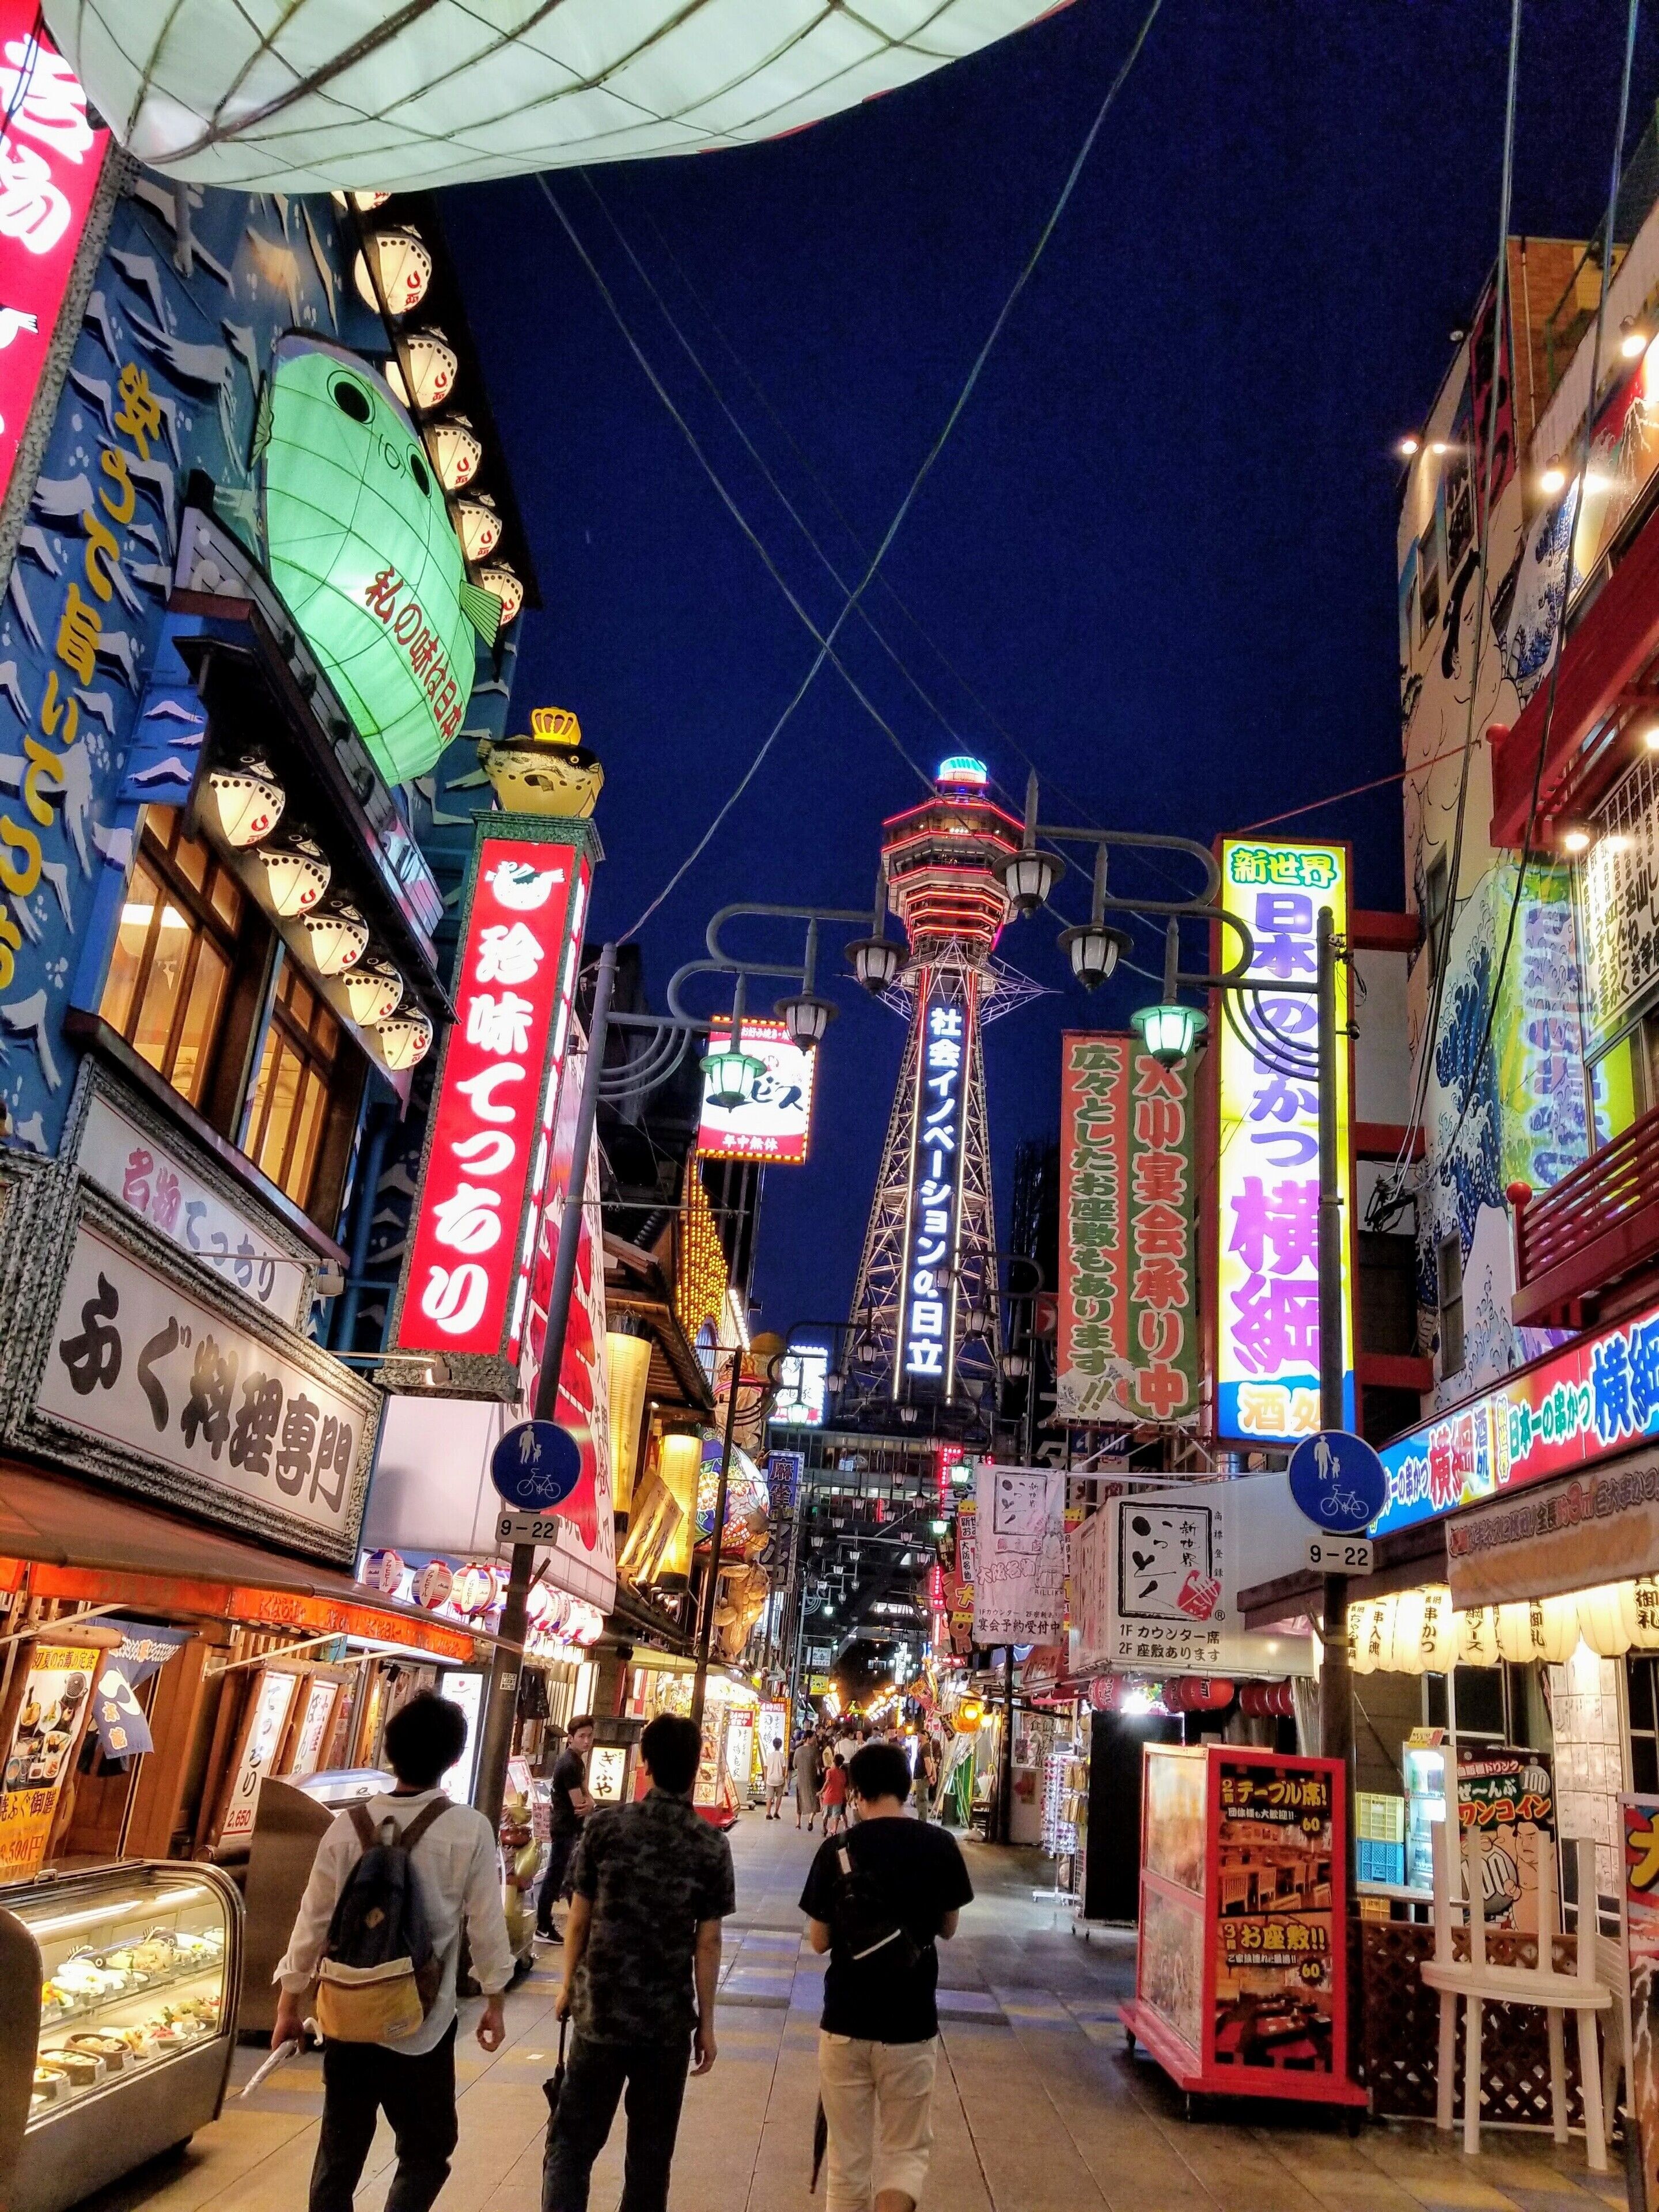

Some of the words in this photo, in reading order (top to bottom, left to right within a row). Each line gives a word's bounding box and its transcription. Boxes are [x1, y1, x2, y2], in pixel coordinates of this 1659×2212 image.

[1232, 849, 1337, 889] 新世界
[1616, 892, 1630, 995] にんにく
[421, 922, 544, 1335] 珍味てっちり
[722, 1134, 779, 1150] 年中無休
[59, 1271, 353, 1513] ふぐ料理専門
[1509, 1385, 1592, 1460] 日本一の串かつ
[768, 1457, 794, 1508] 麻雀
[961, 1541, 972, 1581] 大阪名物
[1214, 1511, 1224, 1578] 商標登録
[977, 1618, 1060, 1635] 宴会予約受付中
[1120, 1624, 1133, 1637] 1F
[1137, 1626, 1221, 1645] カウンター席
[1422, 1606, 1438, 1653] 串かつ
[1119, 1642, 1133, 1655] 2F
[1137, 1643, 1221, 1662] 座敷あります
[243, 1685, 282, 1799] てっちり
[1523, 1771, 1550, 1794] 100
[1302, 1816, 1320, 1832] 60
[1458, 1794, 1552, 1827] ワンコイン
[1302, 1963, 1320, 1979] 60
